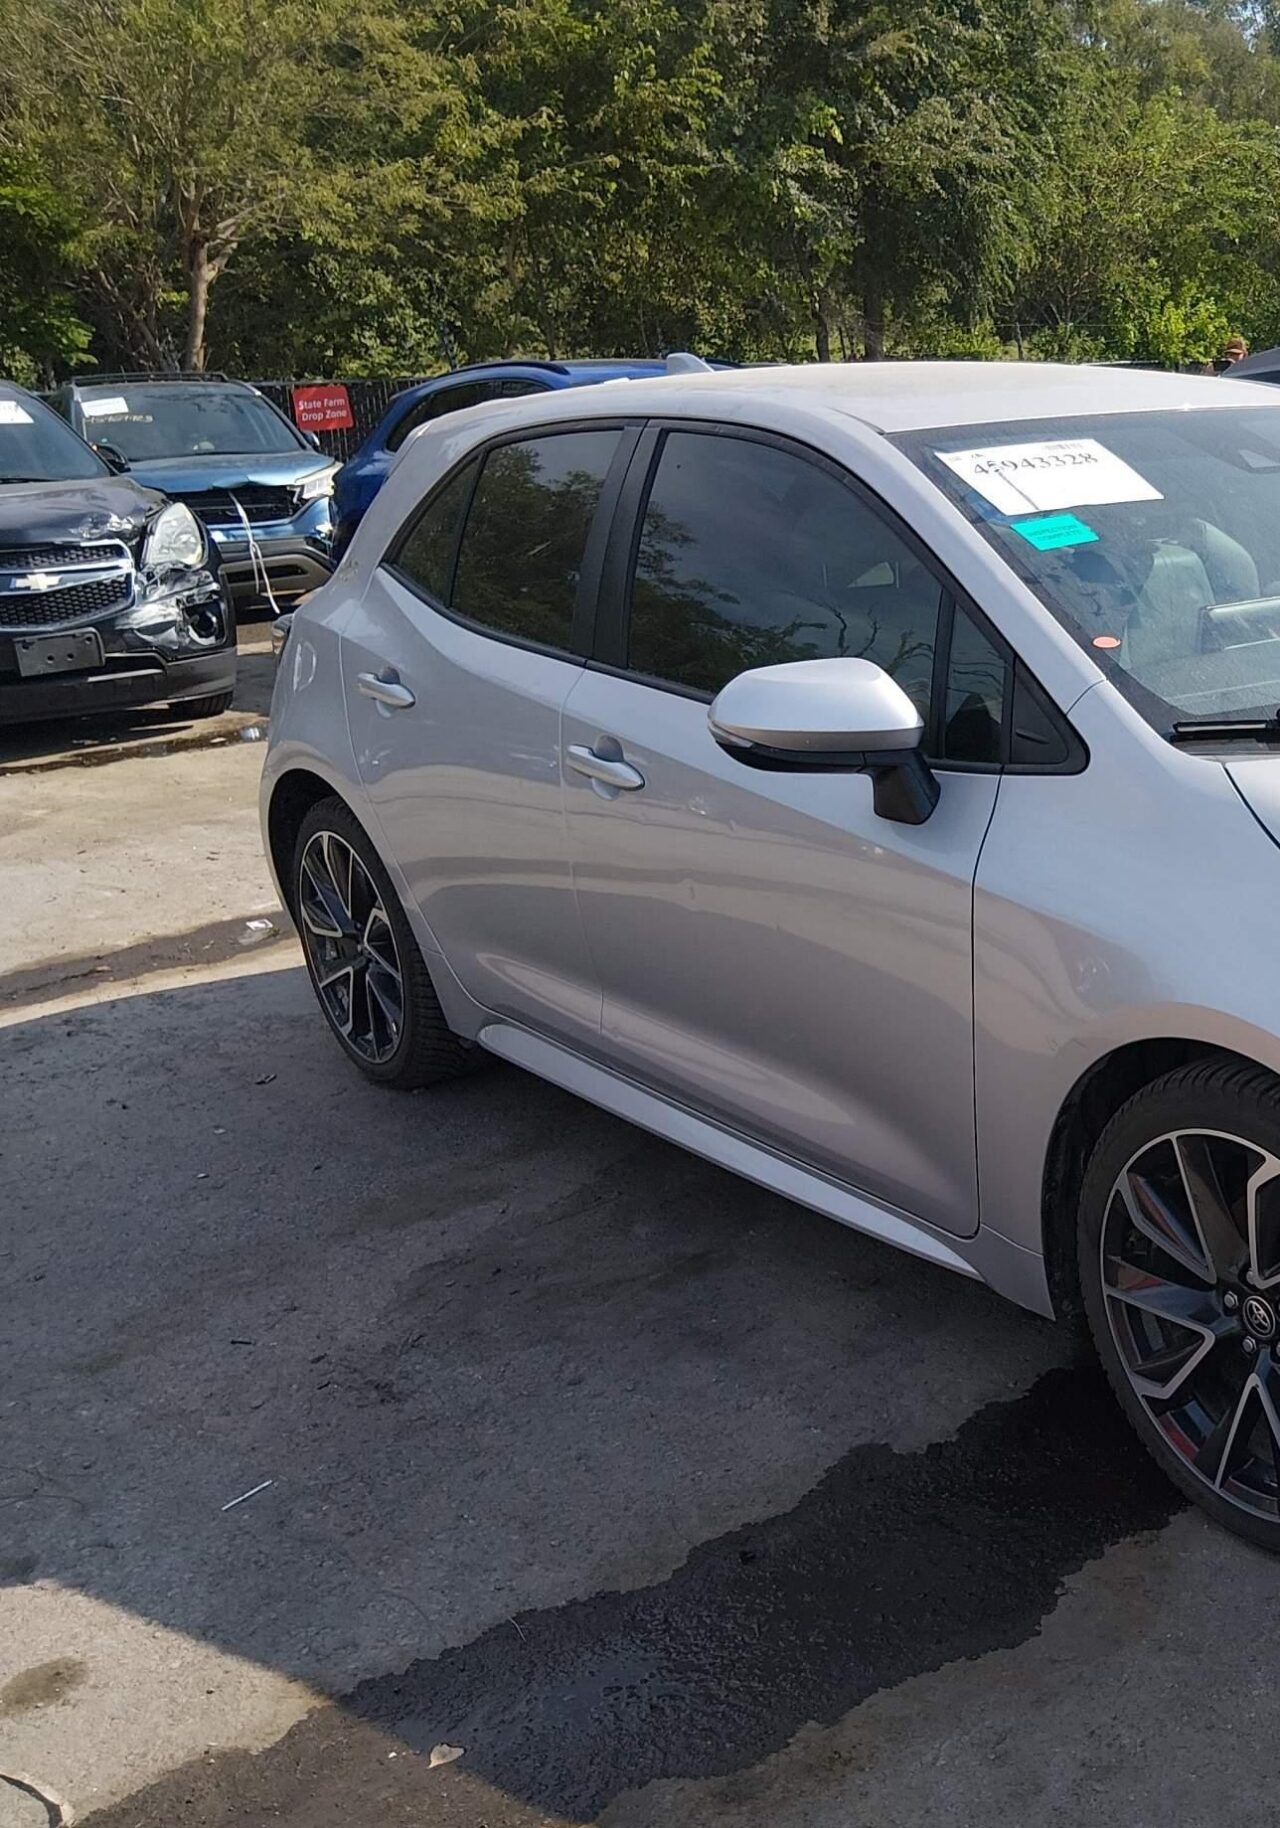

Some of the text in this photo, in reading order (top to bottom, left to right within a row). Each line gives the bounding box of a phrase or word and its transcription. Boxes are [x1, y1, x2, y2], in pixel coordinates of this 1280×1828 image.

[298, 398, 345, 410] State Farm
[302, 409, 347, 422] Drop Zone
[974, 452, 1098, 474] 45943328
